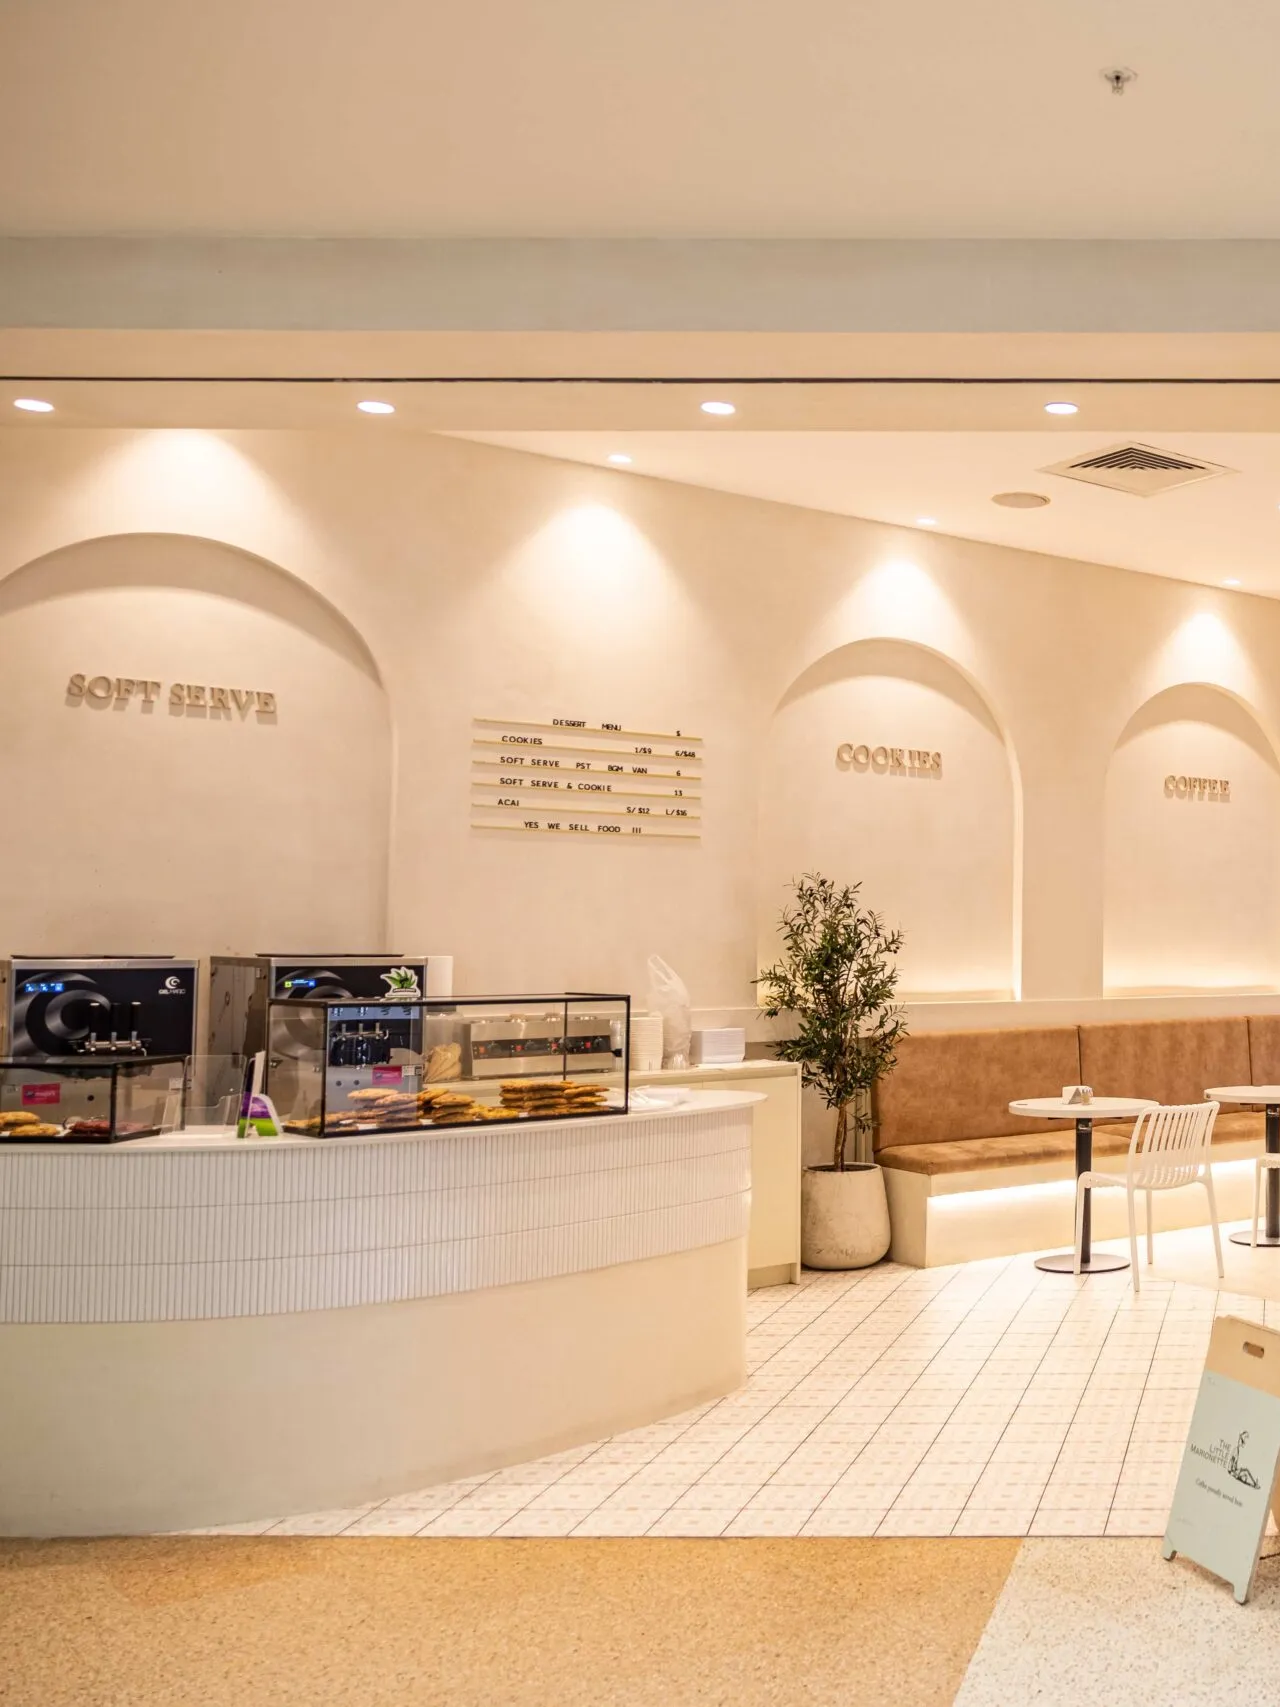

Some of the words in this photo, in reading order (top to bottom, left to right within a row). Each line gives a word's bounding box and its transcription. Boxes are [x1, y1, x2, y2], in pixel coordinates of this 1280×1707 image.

[66, 673, 161, 703] SOFT
[169, 683, 276, 714] SERVE
[552, 718, 586, 728] DESSERT
[601, 723, 622, 732] MENU
[501, 735, 543, 746] COOKIES
[500, 756, 525, 766] SOFT
[530, 758, 560, 768] SERVE
[575, 762, 592, 771] PST
[632, 766, 648, 775] VAN
[836, 742, 942, 771] COOKIES
[499, 777, 525, 787] SOFT
[530, 779, 559, 789] SERVE
[566, 782, 573, 790] &
[577, 783, 612, 793] COOKIE
[674, 789, 683, 797] 13
[1163, 774, 1230, 794] COFFEE
[497, 798, 520, 807] ACAI
[524, 821, 539, 830] YES
[547, 822, 561, 831] WE
[568, 823, 590, 832] SELL
[597, 825, 621, 834] FOOD
[1209, 1443, 1230, 1460] LITTLE
[1219, 1439, 1232, 1452] THE
[1190, 1443, 1229, 1469] MARIONETTE
